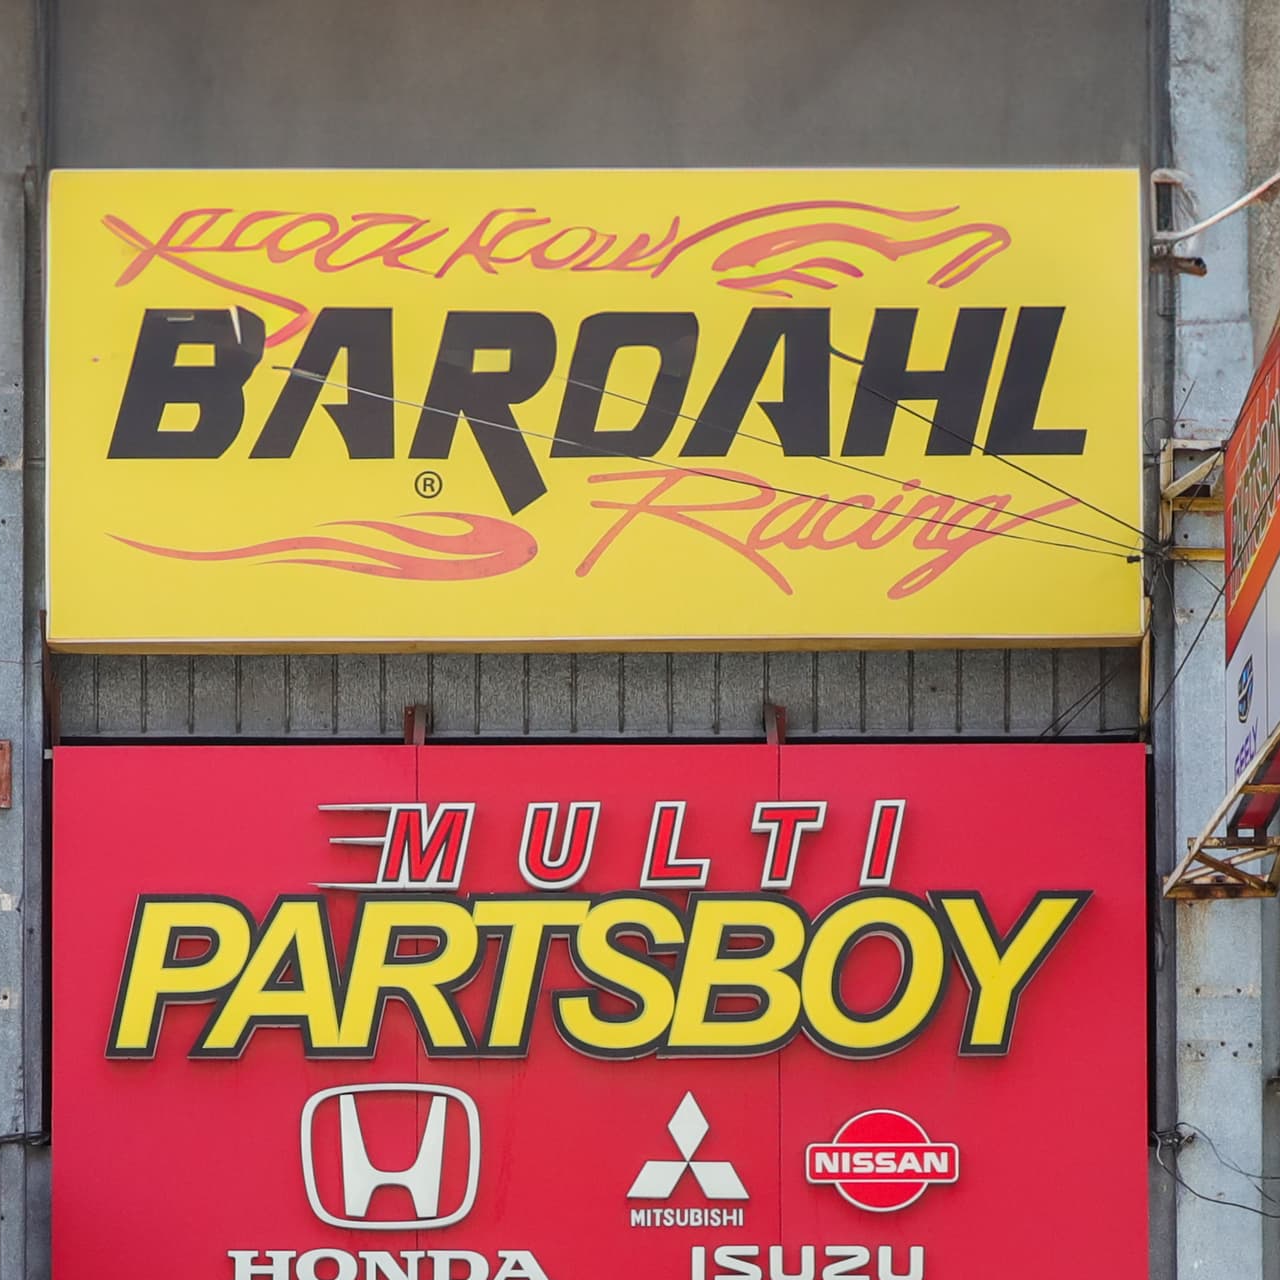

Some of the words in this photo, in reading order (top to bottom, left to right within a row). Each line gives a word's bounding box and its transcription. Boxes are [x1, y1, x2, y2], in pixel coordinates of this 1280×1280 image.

[107, 305, 1088, 516] BARDAHL
[576, 467, 1080, 600] Racing
[378, 798, 907, 892] MULTI
[104, 889, 1096, 1062] PARTSBOY
[629, 1206, 746, 1228] MITSUBISHI
[813, 1150, 952, 1177] NISSAN
